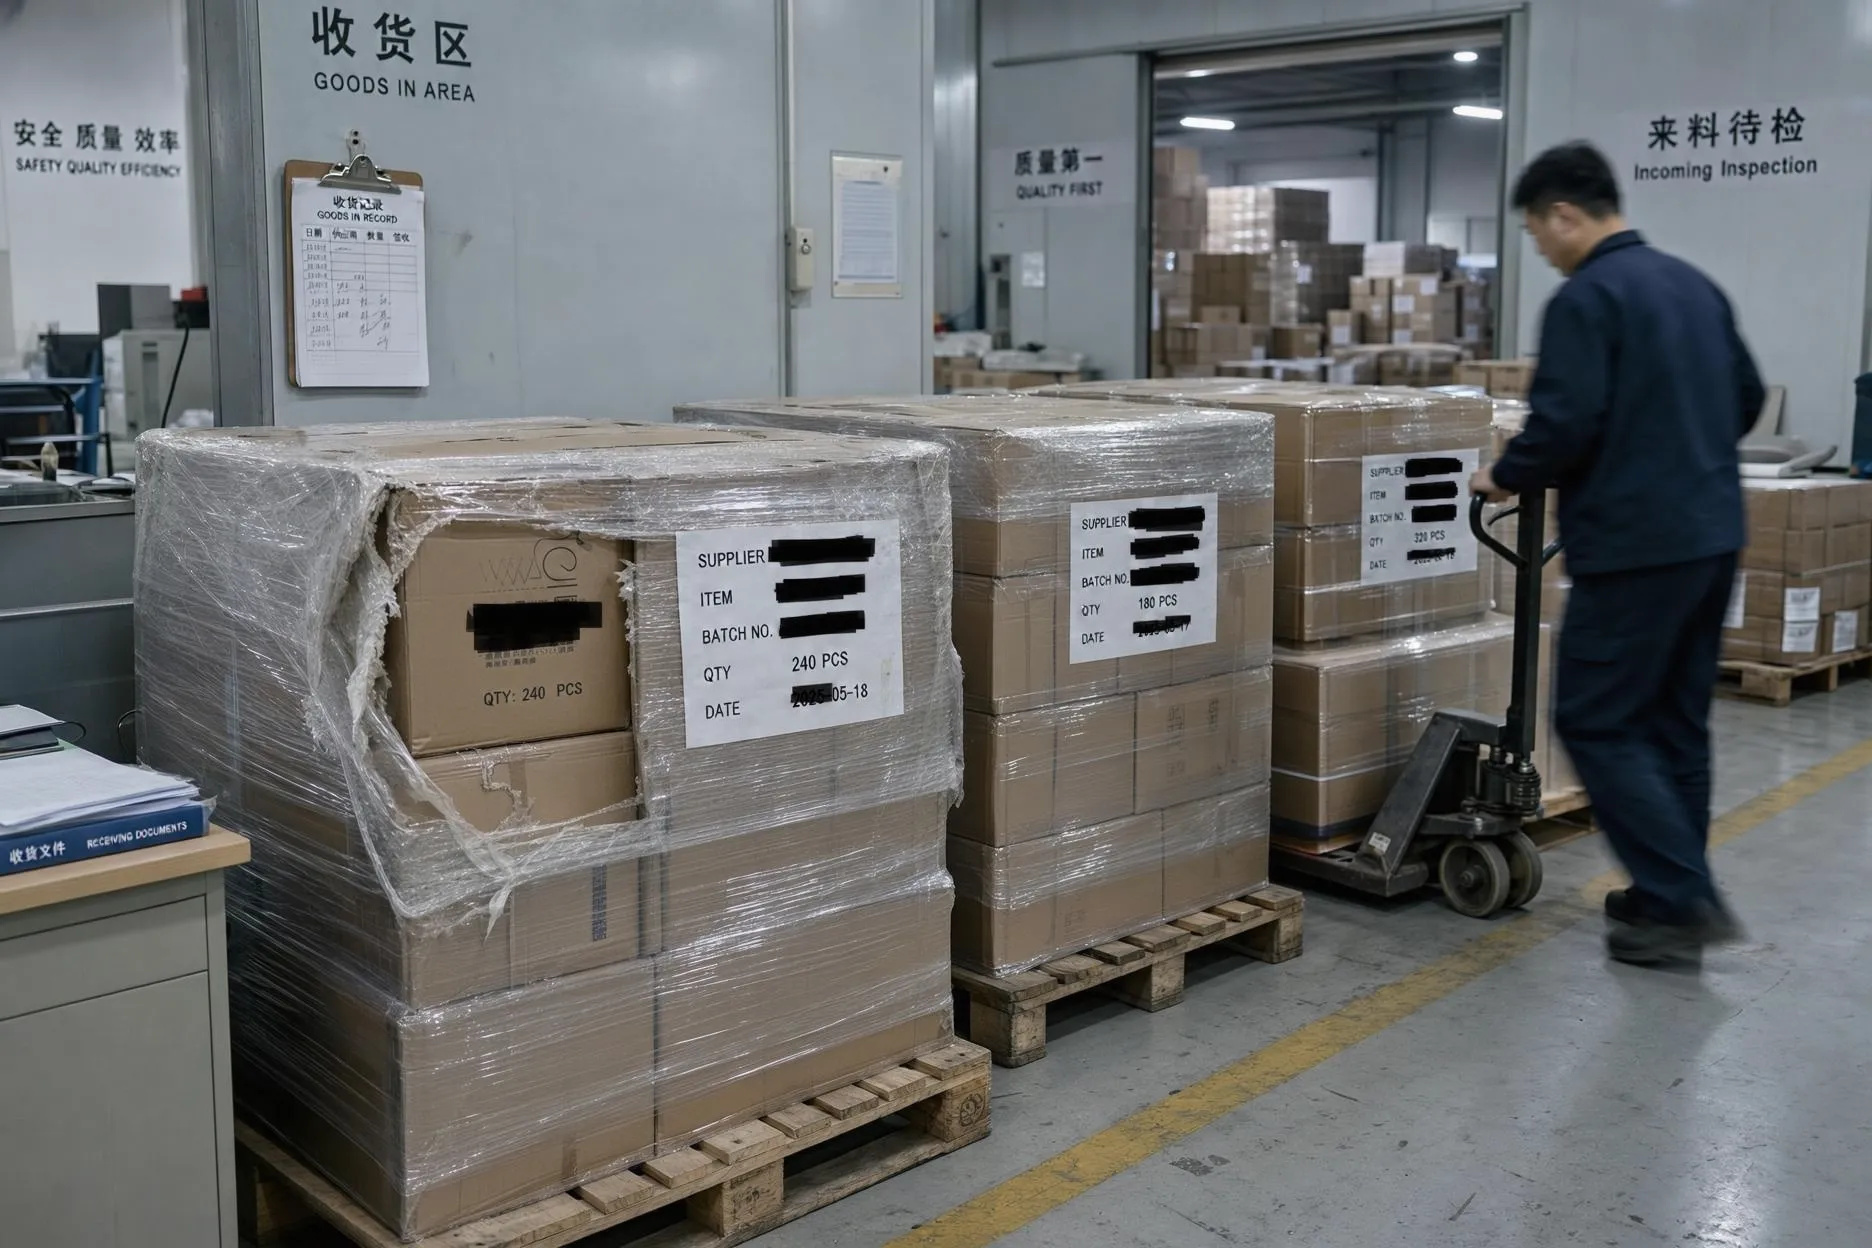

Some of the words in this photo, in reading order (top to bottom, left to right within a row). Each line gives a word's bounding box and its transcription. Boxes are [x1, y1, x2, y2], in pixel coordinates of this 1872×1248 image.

[312, 6, 472, 68] 收货区
[314, 72, 389, 95] GOODS
[398, 79, 416, 97] IN
[424, 81, 476, 102] AREA
[14, 119, 62, 148] 安全
[76, 122, 122, 151] 质量
[135, 127, 180, 154] 效率
[1648, 106, 1805, 151] 来料待检
[16, 157, 62, 173] SAFETY
[67, 159, 117, 175] QUALITY
[121, 162, 181, 178] EFFICIENCY
[1015, 147, 1103, 176] 质量第一
[1634, 160, 1713, 182] Incoming
[1721, 155, 1818, 180] Inspection
[1016, 183, 1065, 200] QUALITY
[1069, 180, 1103, 197] FIRST
[317, 210, 349, 221] GOODS
[351, 213, 360, 221] IN
[363, 213, 398, 224] RECORD
[1370, 466, 1404, 478] SUPPLIER
[1370, 491, 1386, 500] ITEM
[1081, 515, 1127, 530] SUPPLIER
[1370, 514, 1392, 524] BATCH
[1369, 537, 1383, 548] QTY
[1430, 530, 1445, 541] PCS
[698, 549, 765, 568] SUPPLIER
[1082, 547, 1104, 560] ITEM
[1370, 560, 1386, 570] DATE
[1082, 575, 1112, 588] BATCH
[1114, 573, 1130, 585] NO.
[700, 590, 733, 607] ITEM
[1081, 604, 1101, 617] QTY
[1138, 596, 1156, 610] 180
[1159, 594, 1178, 608] PCS
[702, 626, 747, 645] BATCH
[751, 623, 773, 640] NO.
[1081, 632, 1105, 645] DATE
[703, 665, 732, 683] QTY
[792, 655, 816, 672] 240
[822, 651, 849, 668] PCS
[484, 690, 516, 707] QTY:
[522, 686, 546, 702] 240
[557, 682, 583, 697] PCS
[705, 701, 741, 720] DATE
[87, 832, 133, 849] RECEIVING
[135, 821, 188, 840] DOCUMENTS
[9, 840, 67, 865] 收货文件
